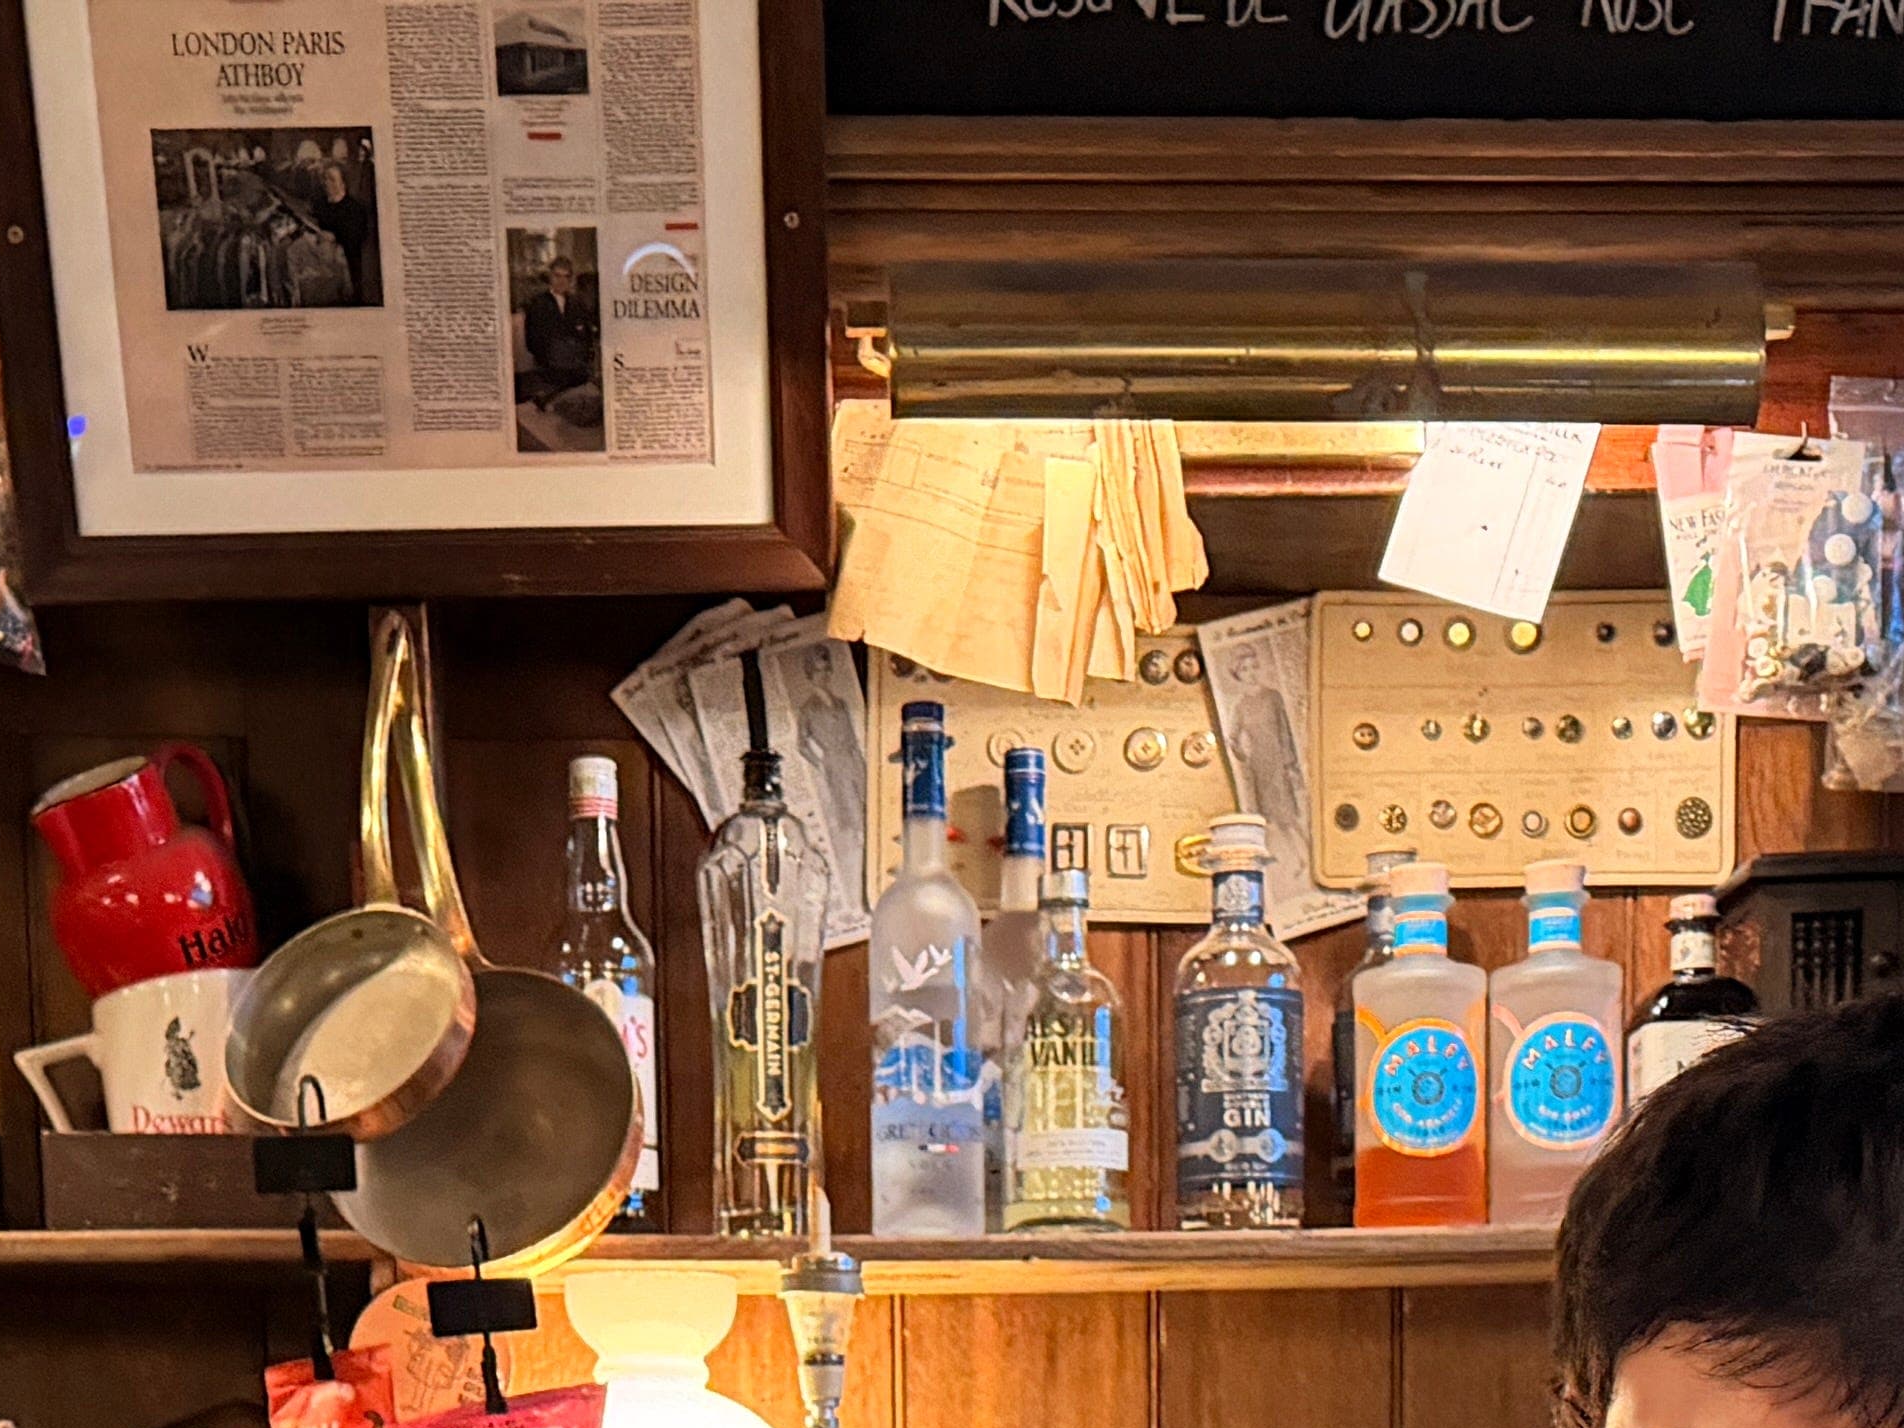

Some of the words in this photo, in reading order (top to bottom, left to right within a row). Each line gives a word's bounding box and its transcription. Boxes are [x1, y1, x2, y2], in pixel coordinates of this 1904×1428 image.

[171, 31, 275, 56] LONDON
[282, 31, 346, 55] PARIS
[216, 62, 305, 87] ATHBOY
[630, 272, 699, 293] DESIGN
[613, 300, 701, 319] DILEMMA
[1384, 1035, 1469, 1076] MALFY
[1522, 1028, 1608, 1070] MALFY
[1223, 1107, 1271, 1128] GIN
